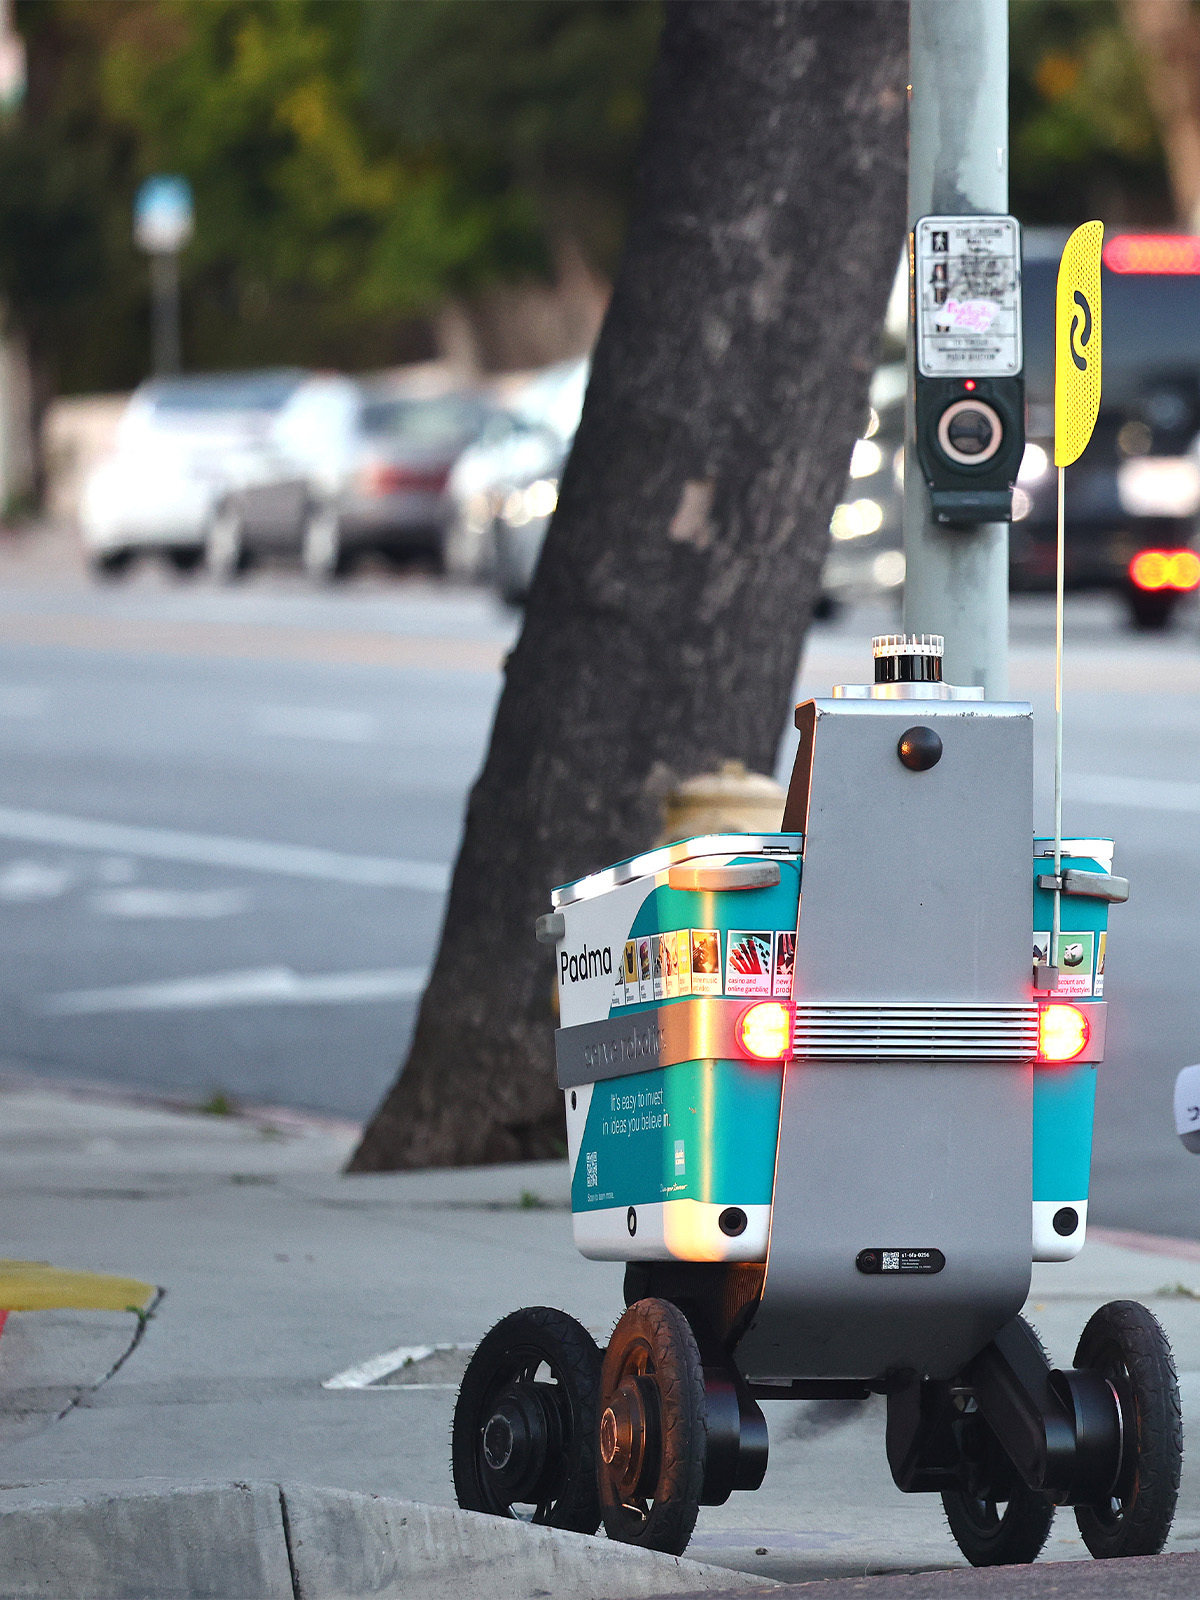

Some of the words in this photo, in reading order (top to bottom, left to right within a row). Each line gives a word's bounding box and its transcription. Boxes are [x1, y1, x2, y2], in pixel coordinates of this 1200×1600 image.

[561, 944, 612, 985] Padma
[745, 985, 769, 994] gambling
[1070, 986, 1091, 995] lifestyles
[611, 1093, 621, 1111] It's
[622, 1095, 637, 1114] easy
[638, 1091, 645, 1107] to
[645, 1088, 664, 1105] invest
[602, 1117, 609, 1136] in
[611, 1116, 627, 1134] ideas
[627, 1118, 640, 1137] you
[641, 1110, 662, 1130] believe
[663, 1109, 671, 1127] in.
